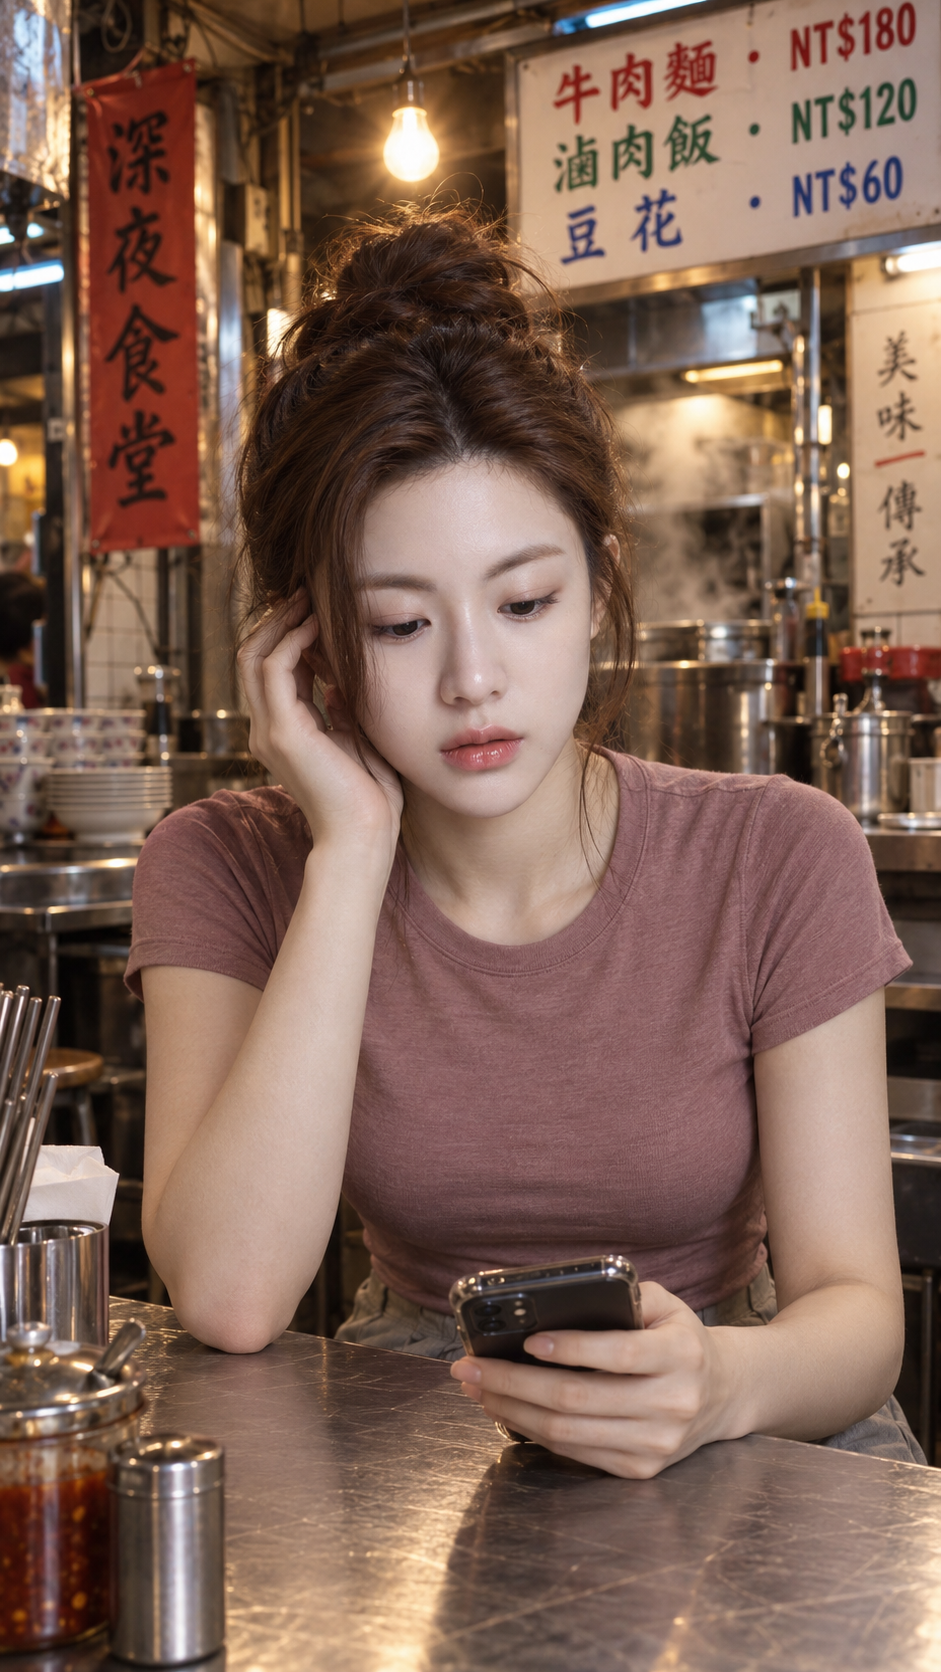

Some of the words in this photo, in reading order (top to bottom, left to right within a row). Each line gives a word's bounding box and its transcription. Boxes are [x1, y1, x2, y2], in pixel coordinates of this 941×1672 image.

[553, 39, 718, 125] 牛肉麵
[790, 2, 916, 71] NT$180
[553, 114, 720, 194] 滷肉飯
[792, 78, 917, 144] NT$120
[793, 156, 904, 218] NT$60
[105, 110, 180, 508] 深夜食堂
